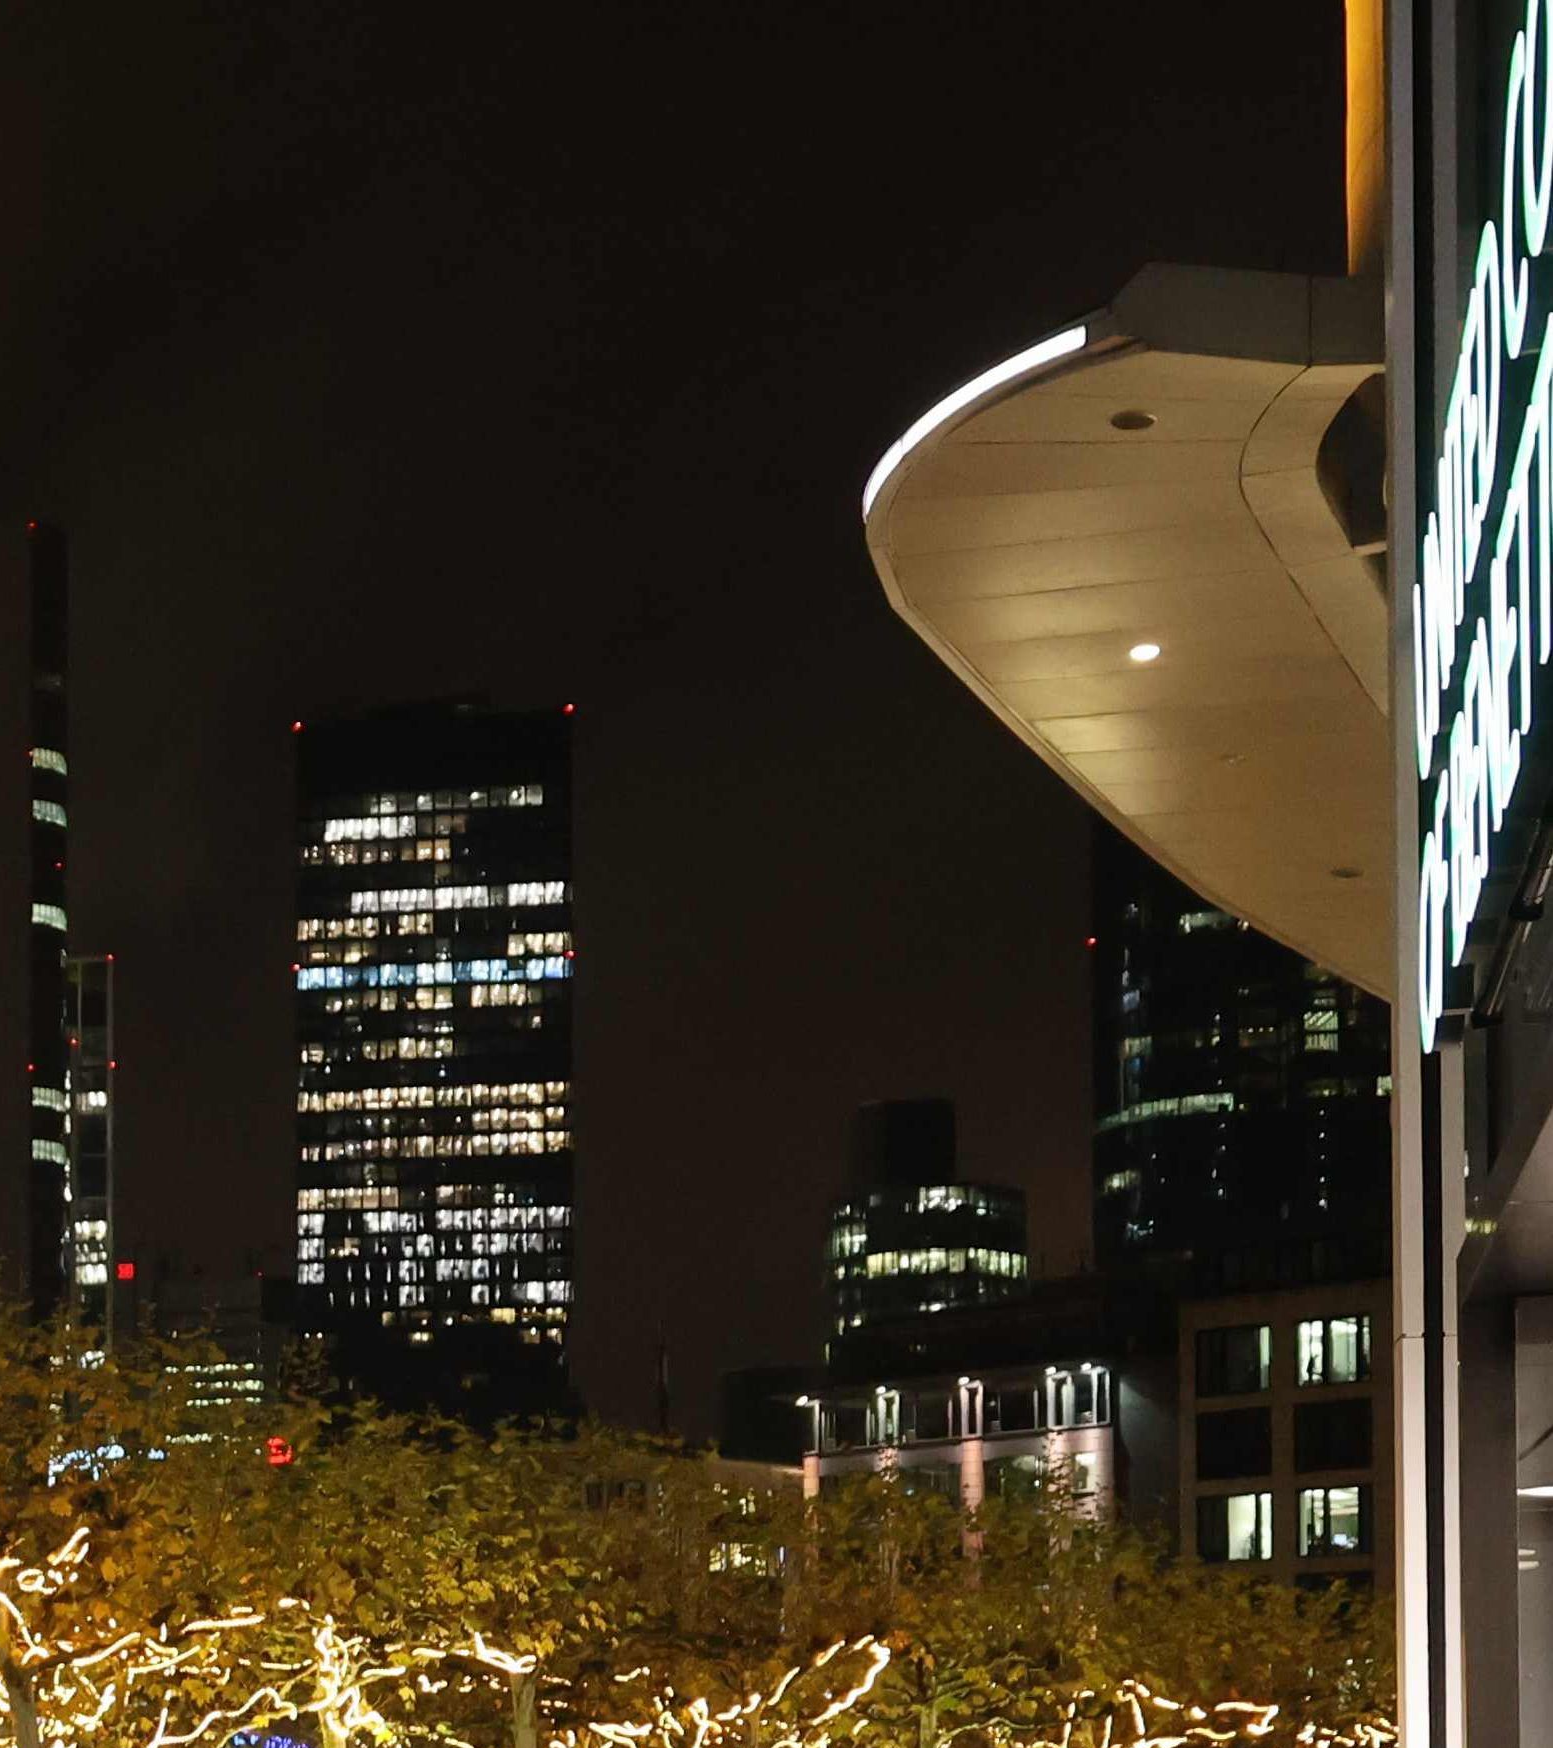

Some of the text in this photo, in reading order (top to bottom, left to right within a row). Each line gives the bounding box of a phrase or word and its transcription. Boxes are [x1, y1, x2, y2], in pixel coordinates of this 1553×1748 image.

[1413, 220, 1501, 780] UNITED
[1419, 312, 1553, 1054] OF BENETT
